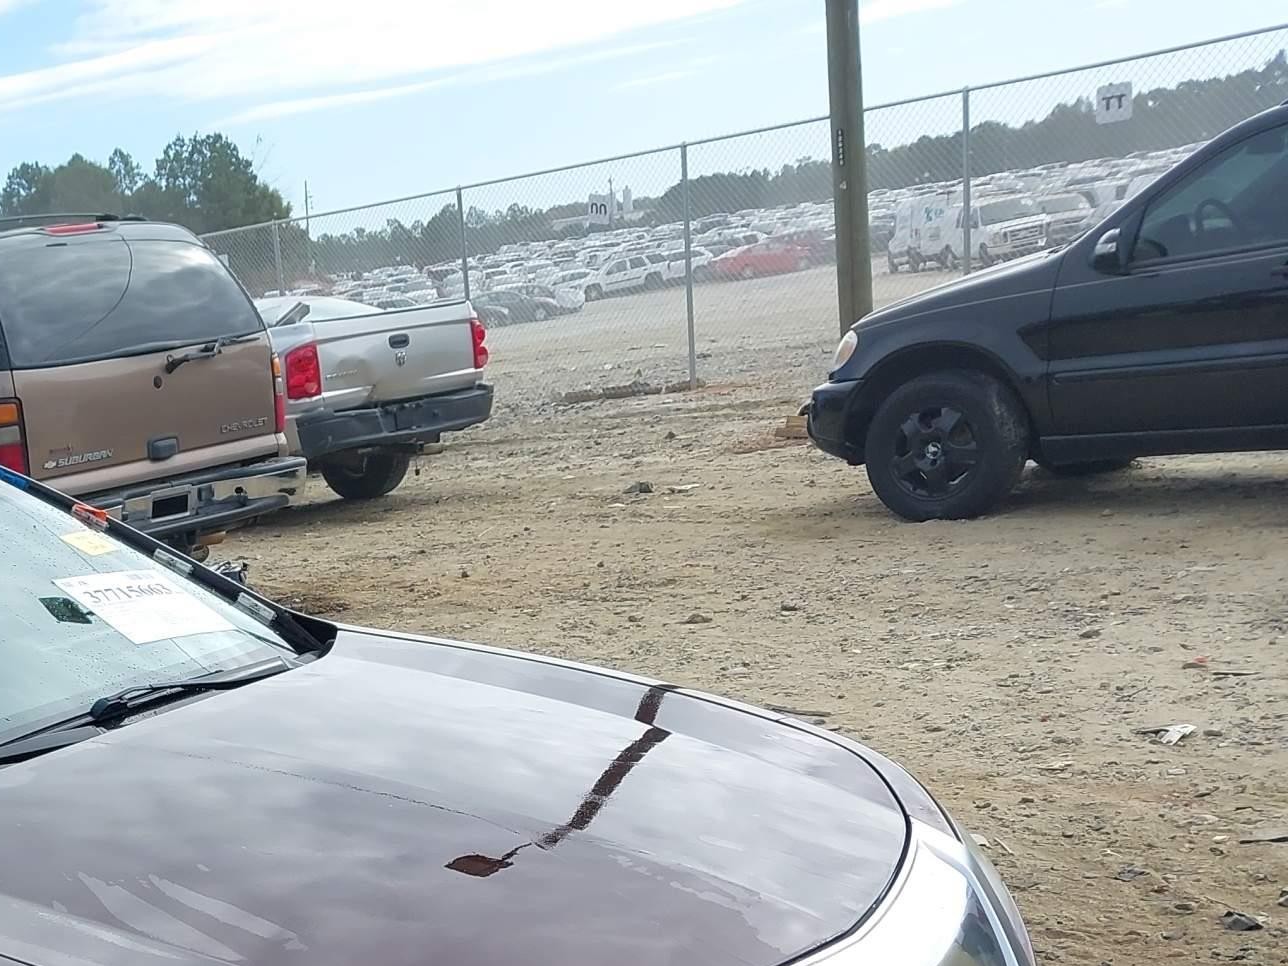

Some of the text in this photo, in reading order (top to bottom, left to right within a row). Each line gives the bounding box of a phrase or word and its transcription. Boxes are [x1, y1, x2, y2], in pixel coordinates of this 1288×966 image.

[1102, 93, 1127, 112] TT
[220, 416, 268, 433] CHEVROLET
[56, 448, 113, 467] SUBURBAN
[83, 583, 172, 603] 37715663
